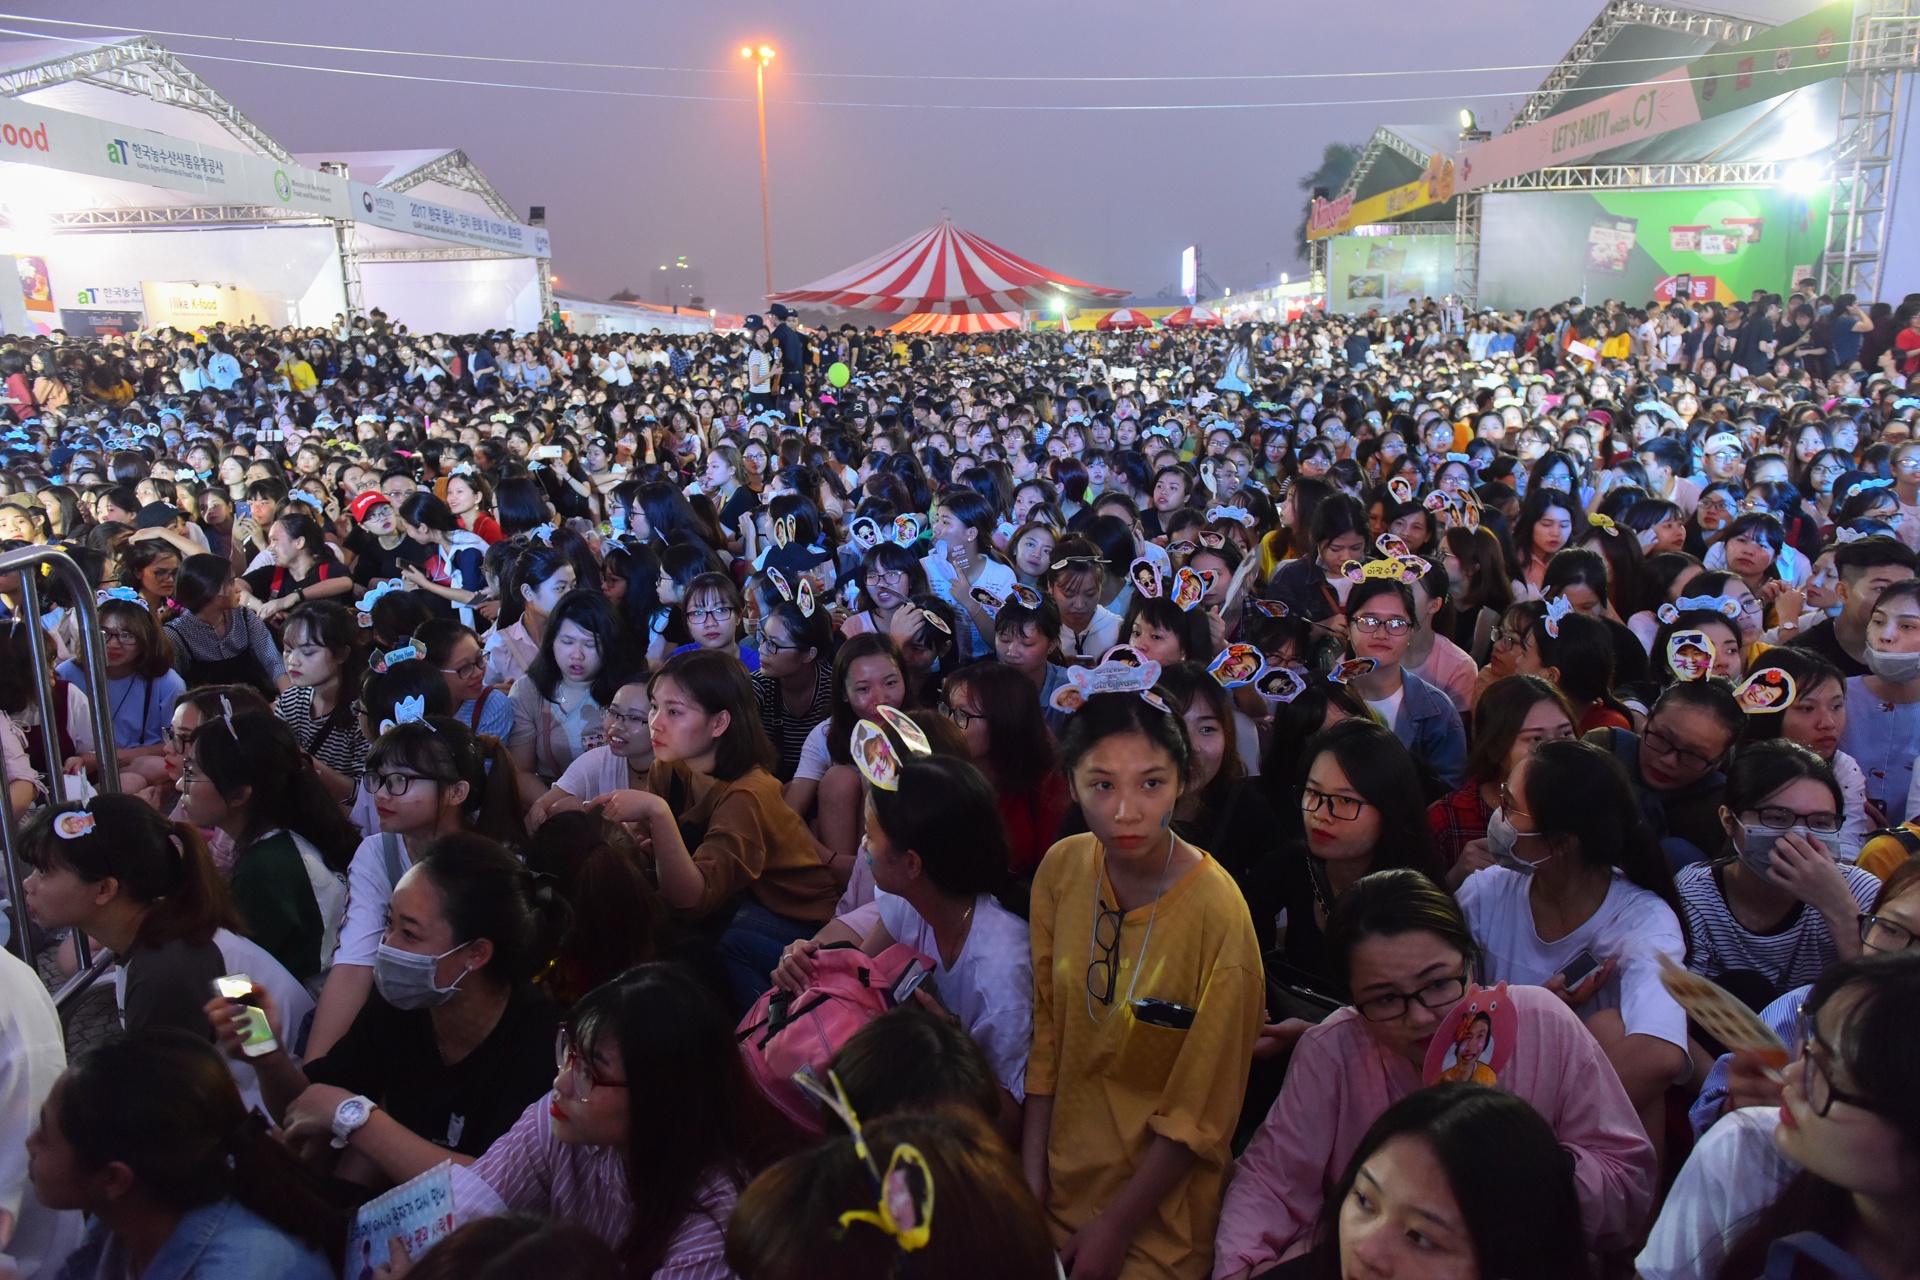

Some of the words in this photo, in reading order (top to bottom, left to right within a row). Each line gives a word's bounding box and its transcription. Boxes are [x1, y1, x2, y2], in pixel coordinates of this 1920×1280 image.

[1552, 121, 1578, 153] LET'S
[1578, 109, 1610, 145] PARTY
[1633, 89, 1657, 130] CJ
[0, 121, 50, 152] ood
[107, 138, 129, 166] aT
[131, 142, 224, 176] 한국농수산식품유통공사
[410, 202, 427, 219] 2017
[78, 287, 99, 304] aT
[173, 297, 189, 309] like
[191, 297, 217, 310] K-food
[1367, 566, 1391, 575] 이광수
